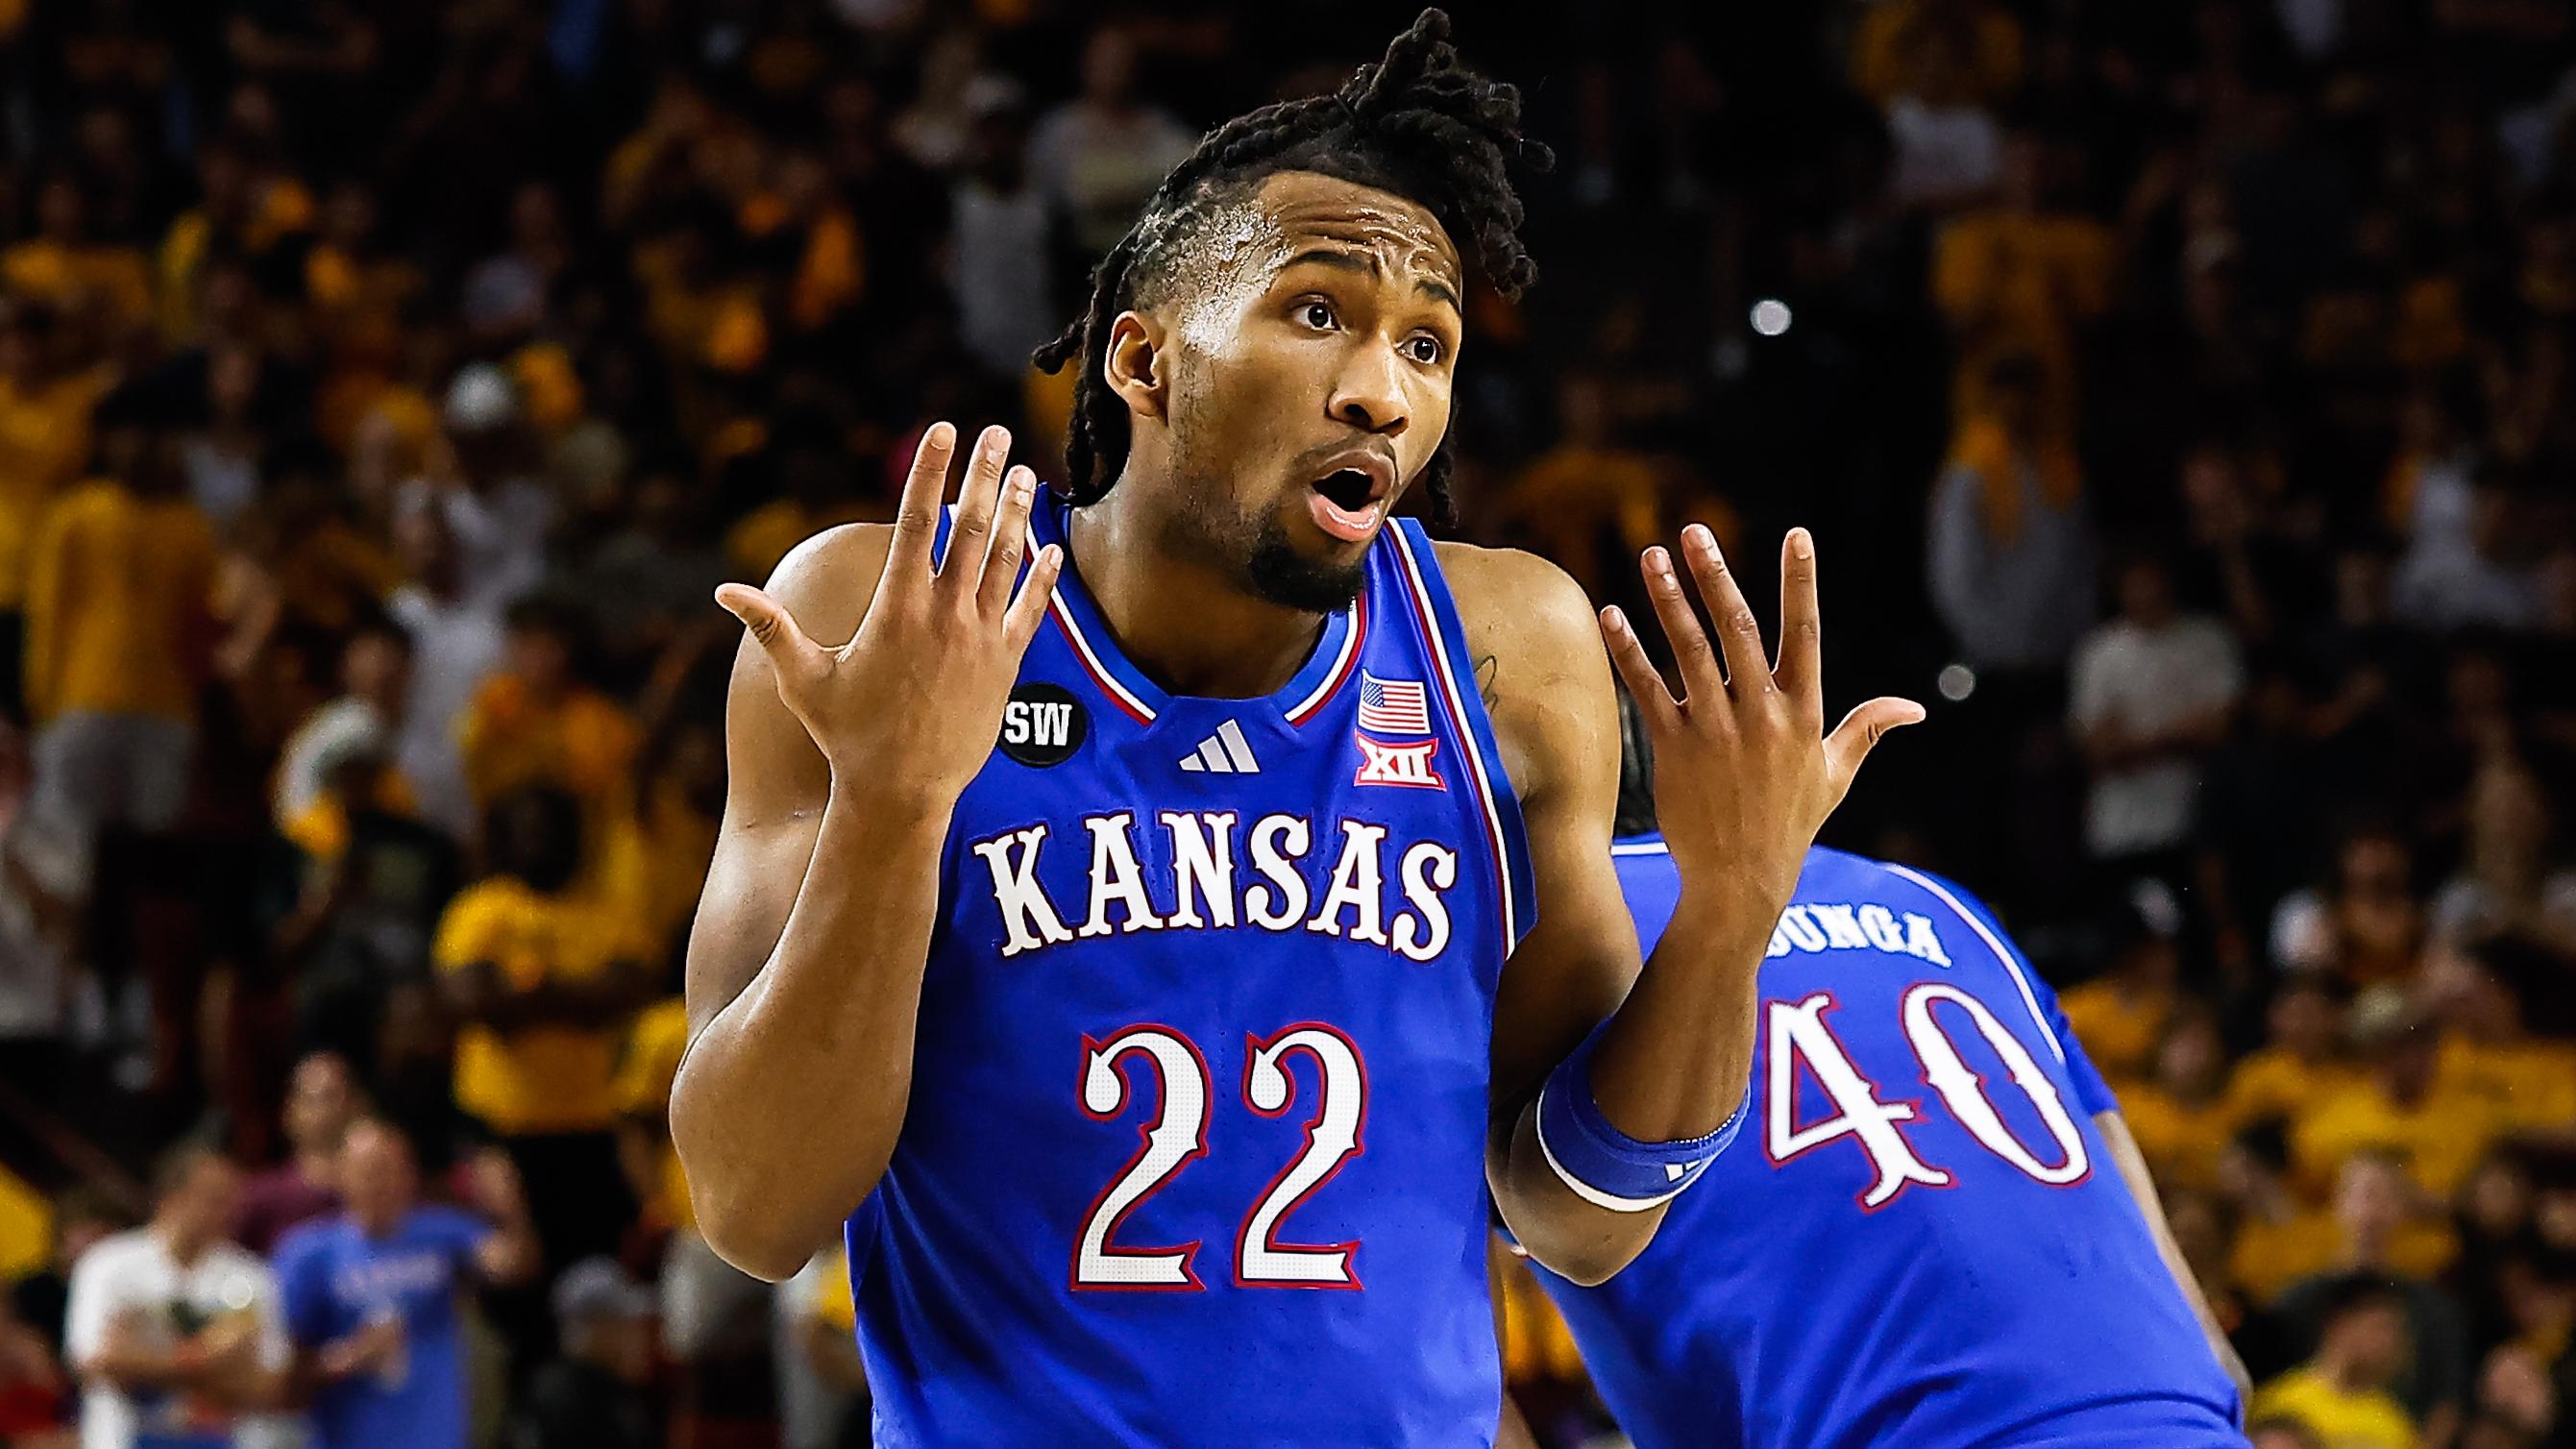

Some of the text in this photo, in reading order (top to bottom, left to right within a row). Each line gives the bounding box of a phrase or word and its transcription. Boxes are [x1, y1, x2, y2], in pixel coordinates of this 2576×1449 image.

[1004, 700, 1073, 748] SW
[1355, 732, 1444, 789] XII
[973, 810, 1458, 962] KANSAS
[1069, 1020, 1368, 1291] 22
[1765, 982, 2093, 1213] 40
